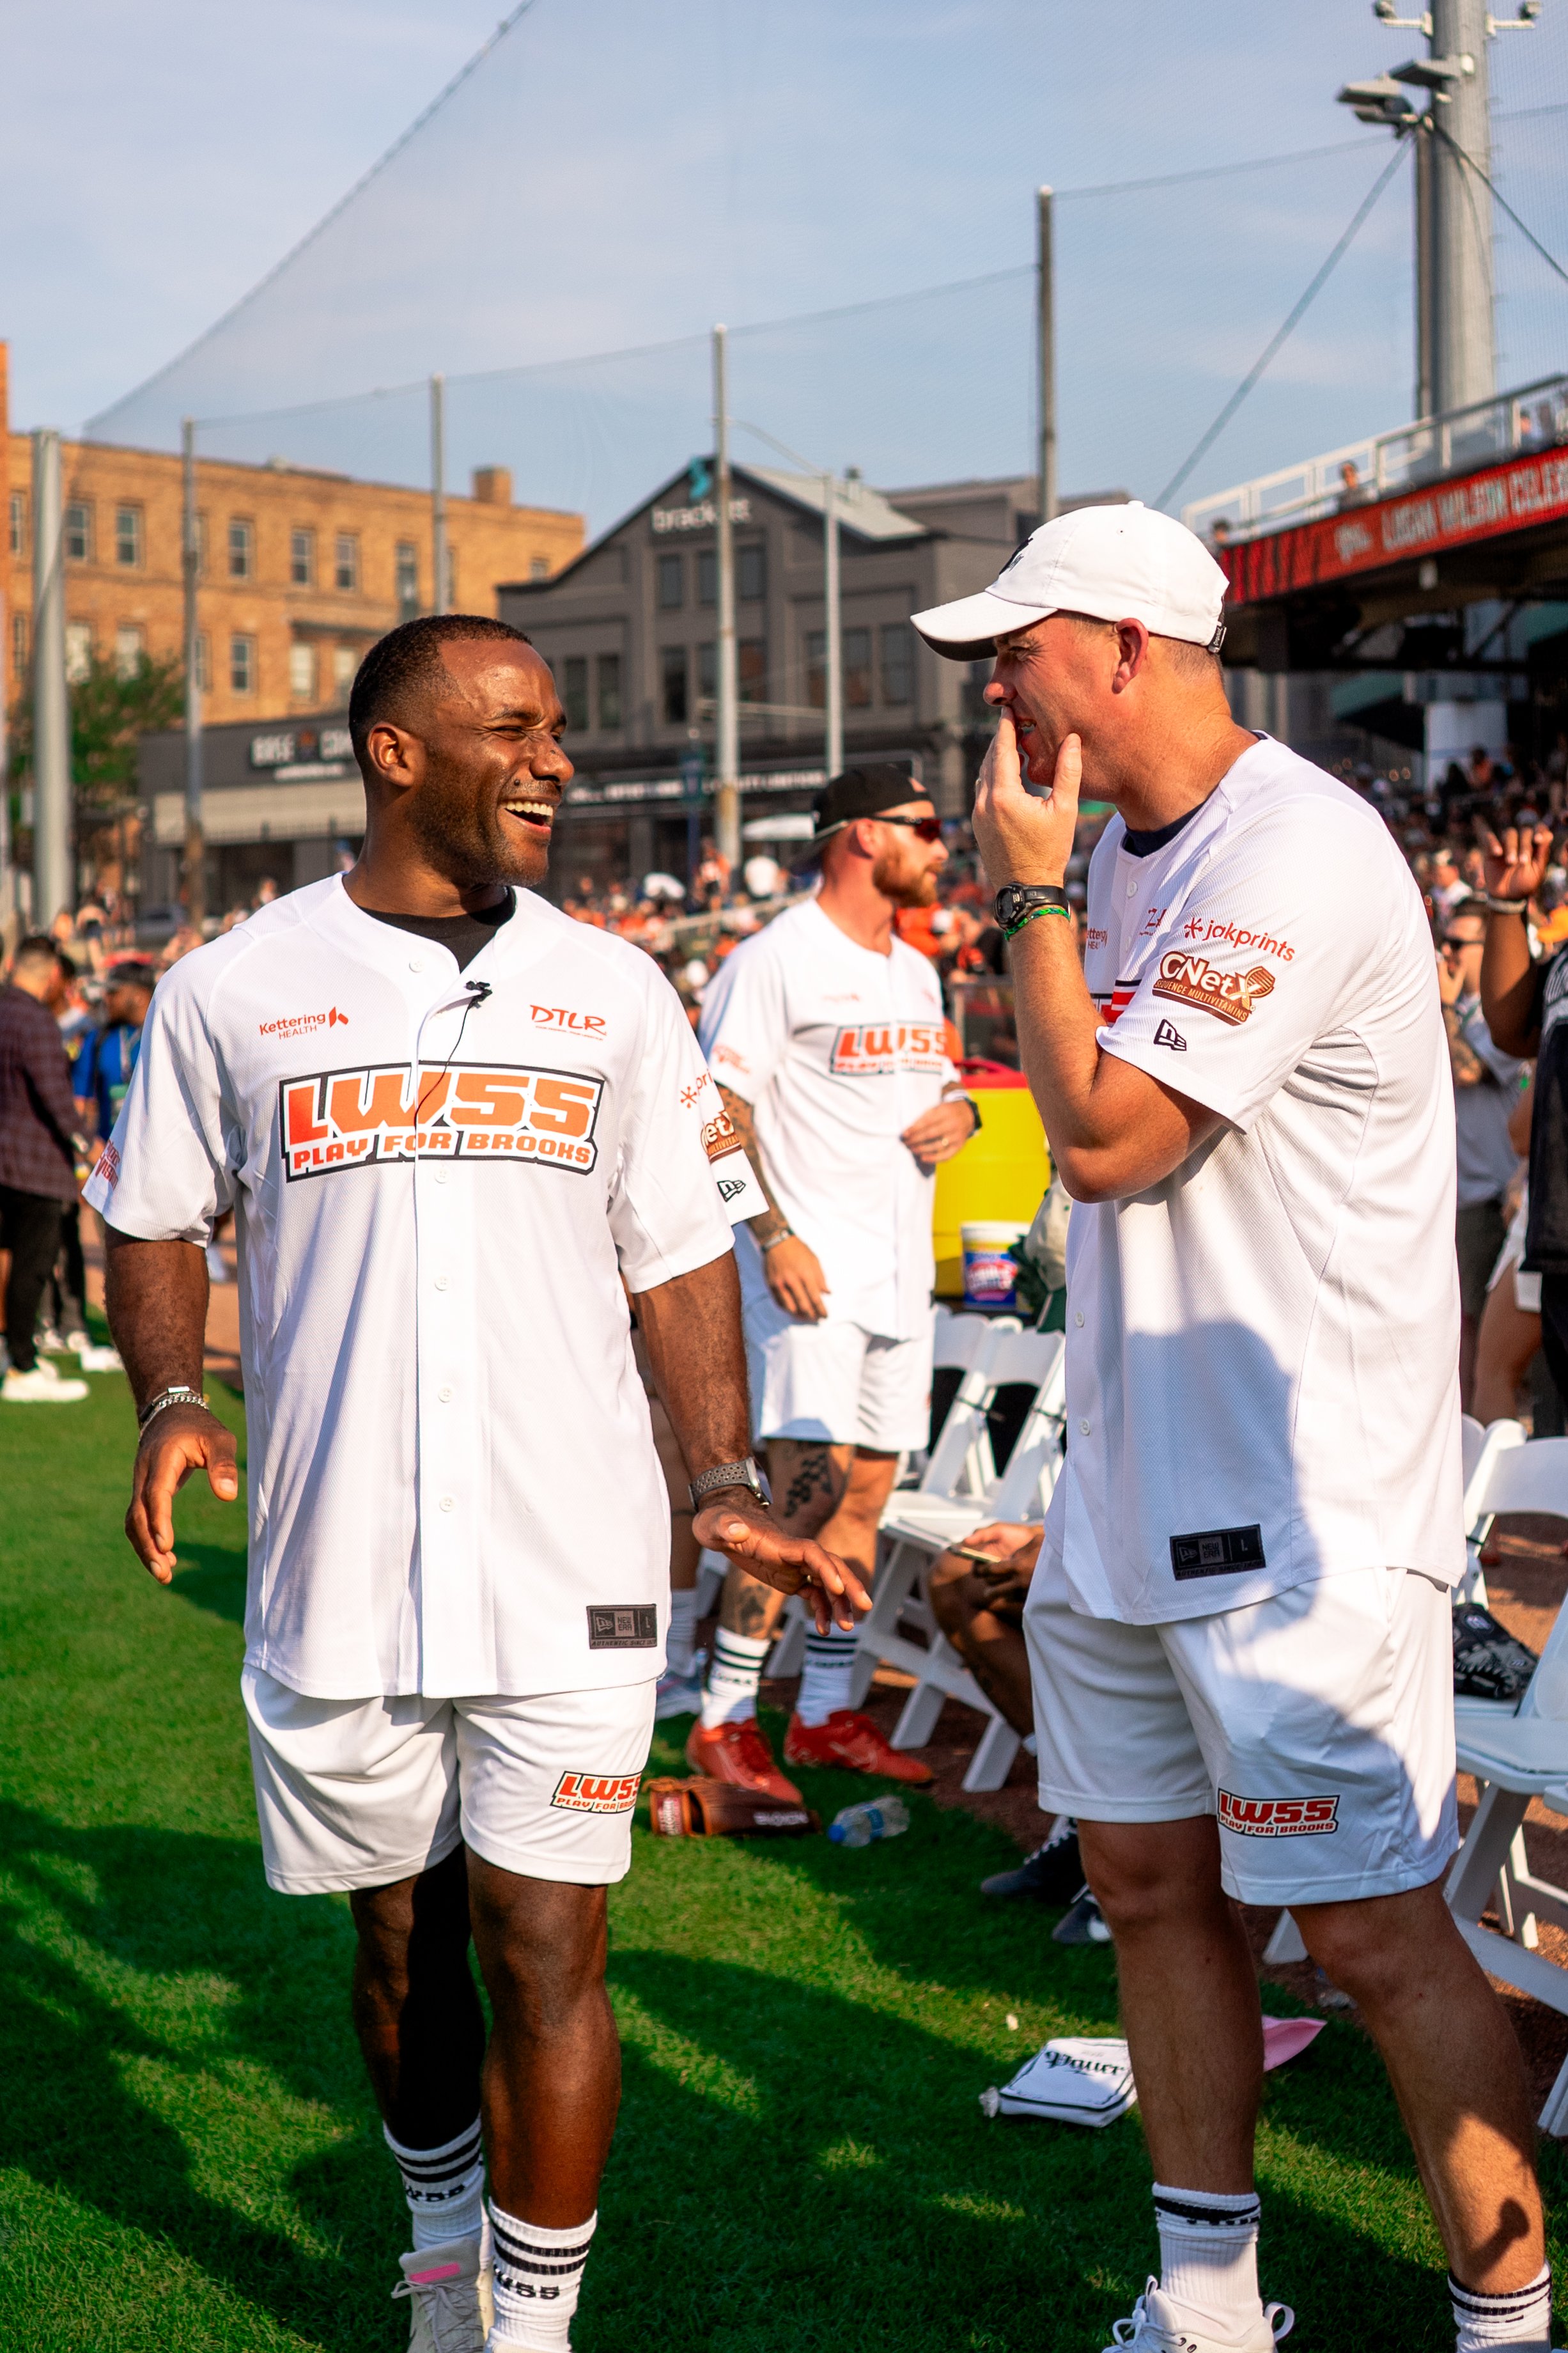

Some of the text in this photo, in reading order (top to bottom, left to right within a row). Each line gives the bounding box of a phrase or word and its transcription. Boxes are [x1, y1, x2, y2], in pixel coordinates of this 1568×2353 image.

[1202, 919, 1295, 961] jakprints
[1154, 980, 1248, 1021] SEQUENCE MULTIVITAMINS
[259, 1013, 325, 1036] Kettering
[530, 1005, 607, 1036] DTLR
[279, 1025, 317, 1040] HEALTH
[293, 1132, 591, 1169] PLAY FOR BROOKS
[1202, 1543, 1220, 1551] NEW
[557, 1797, 591, 1808] PLAY
[1220, 1815, 1334, 1834] PLAY FOR BROOKS
